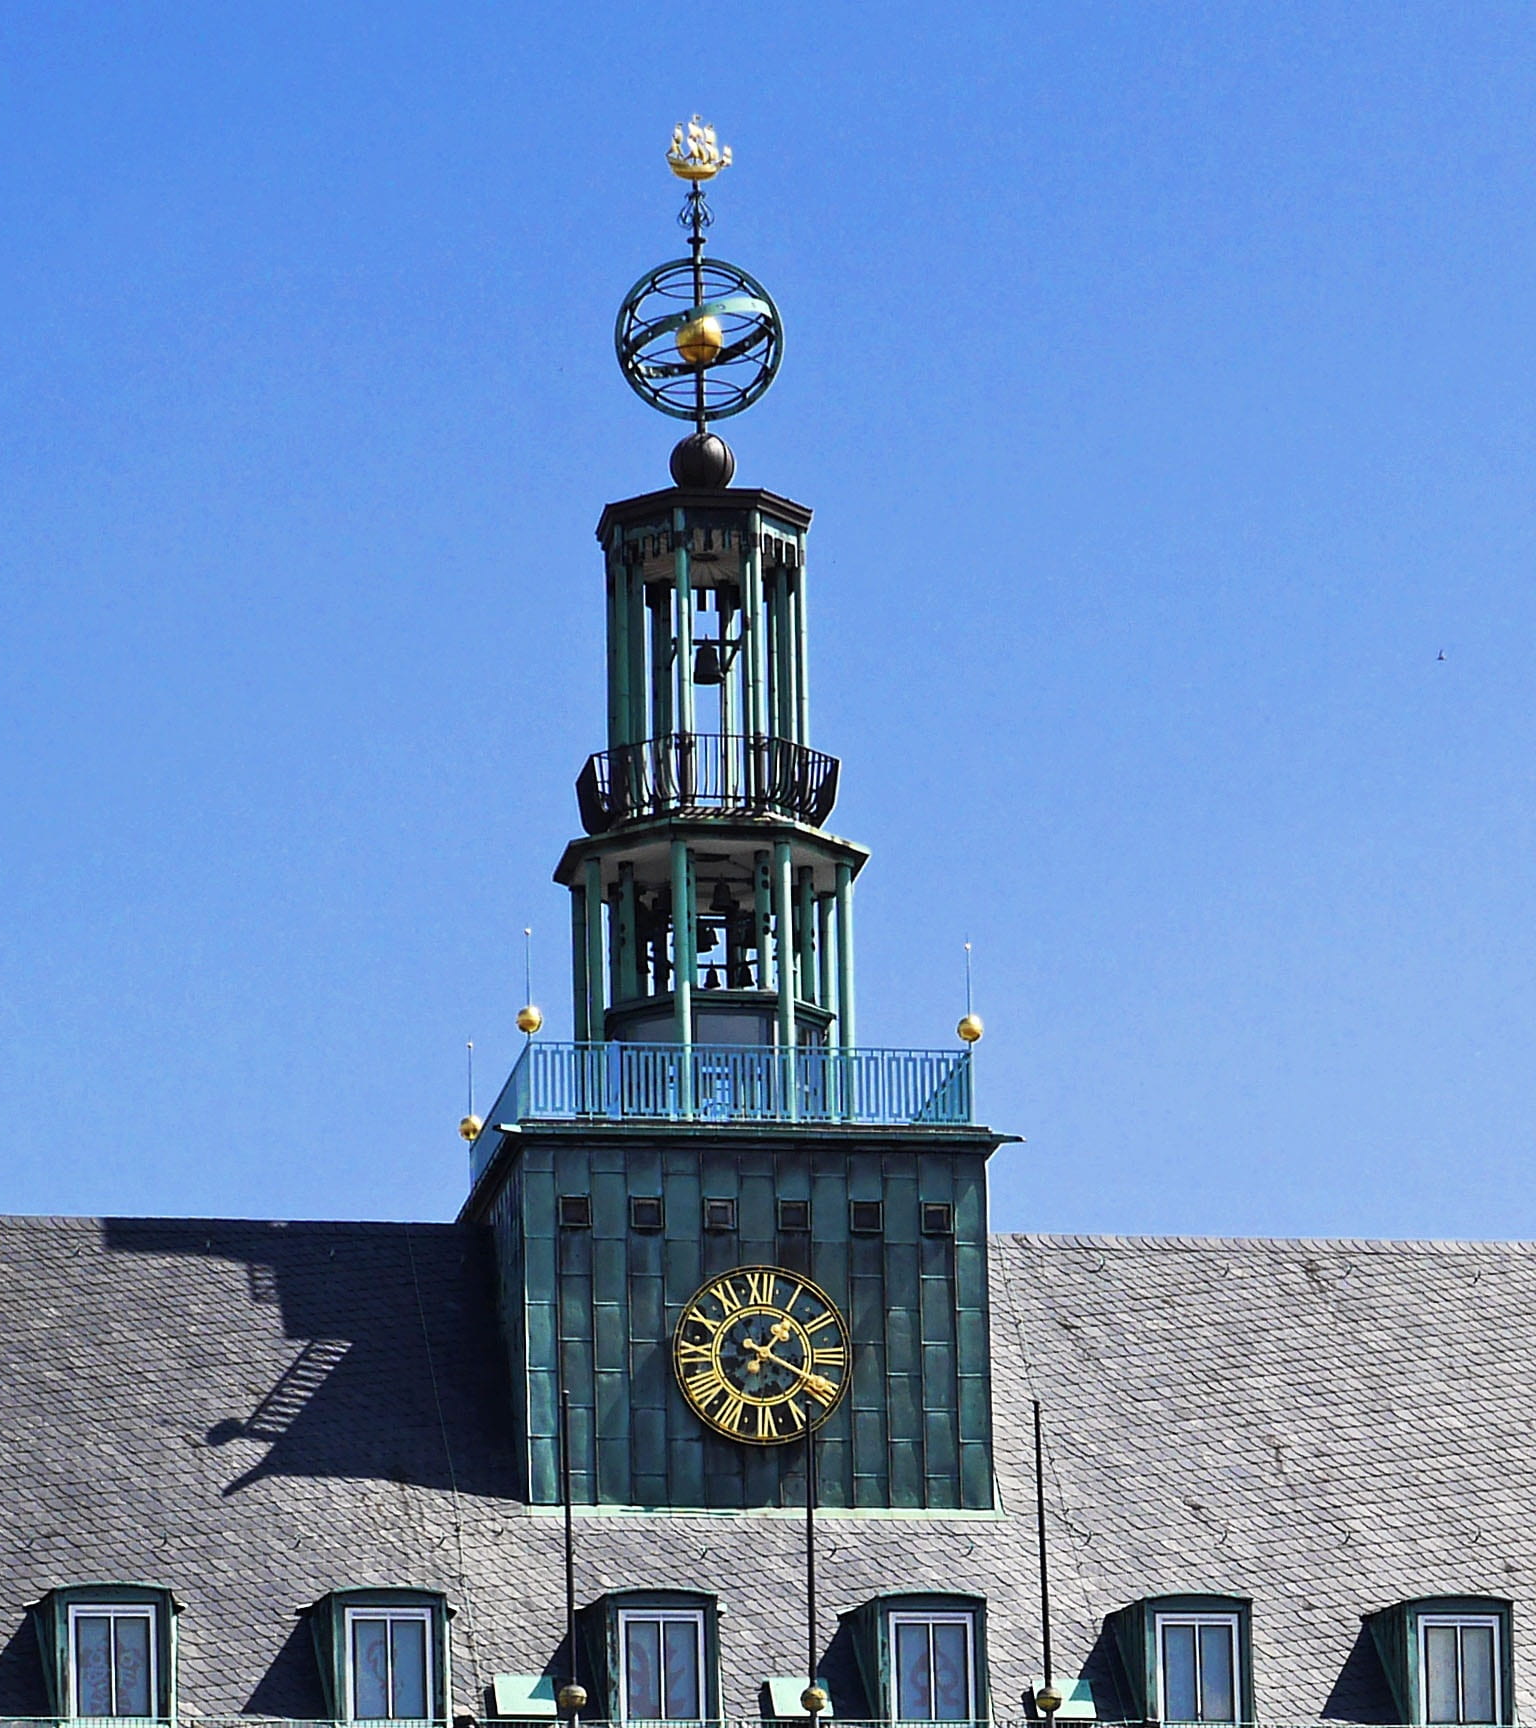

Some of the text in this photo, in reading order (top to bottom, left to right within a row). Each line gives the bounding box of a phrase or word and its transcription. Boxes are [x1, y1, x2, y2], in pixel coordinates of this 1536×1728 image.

[710, 1280, 742, 1315] XI
[746, 1273, 775, 1305] XII
[786, 1284, 803, 1312] I
[688, 1307, 721, 1334] X
[804, 1311, 836, 1334] II
[680, 1340, 712, 1364] IX
[813, 1347, 844, 1366] III
[686, 1370, 724, 1410] VIII
[714, 1395, 743, 1432] VII
[757, 1406, 779, 1437] VI
